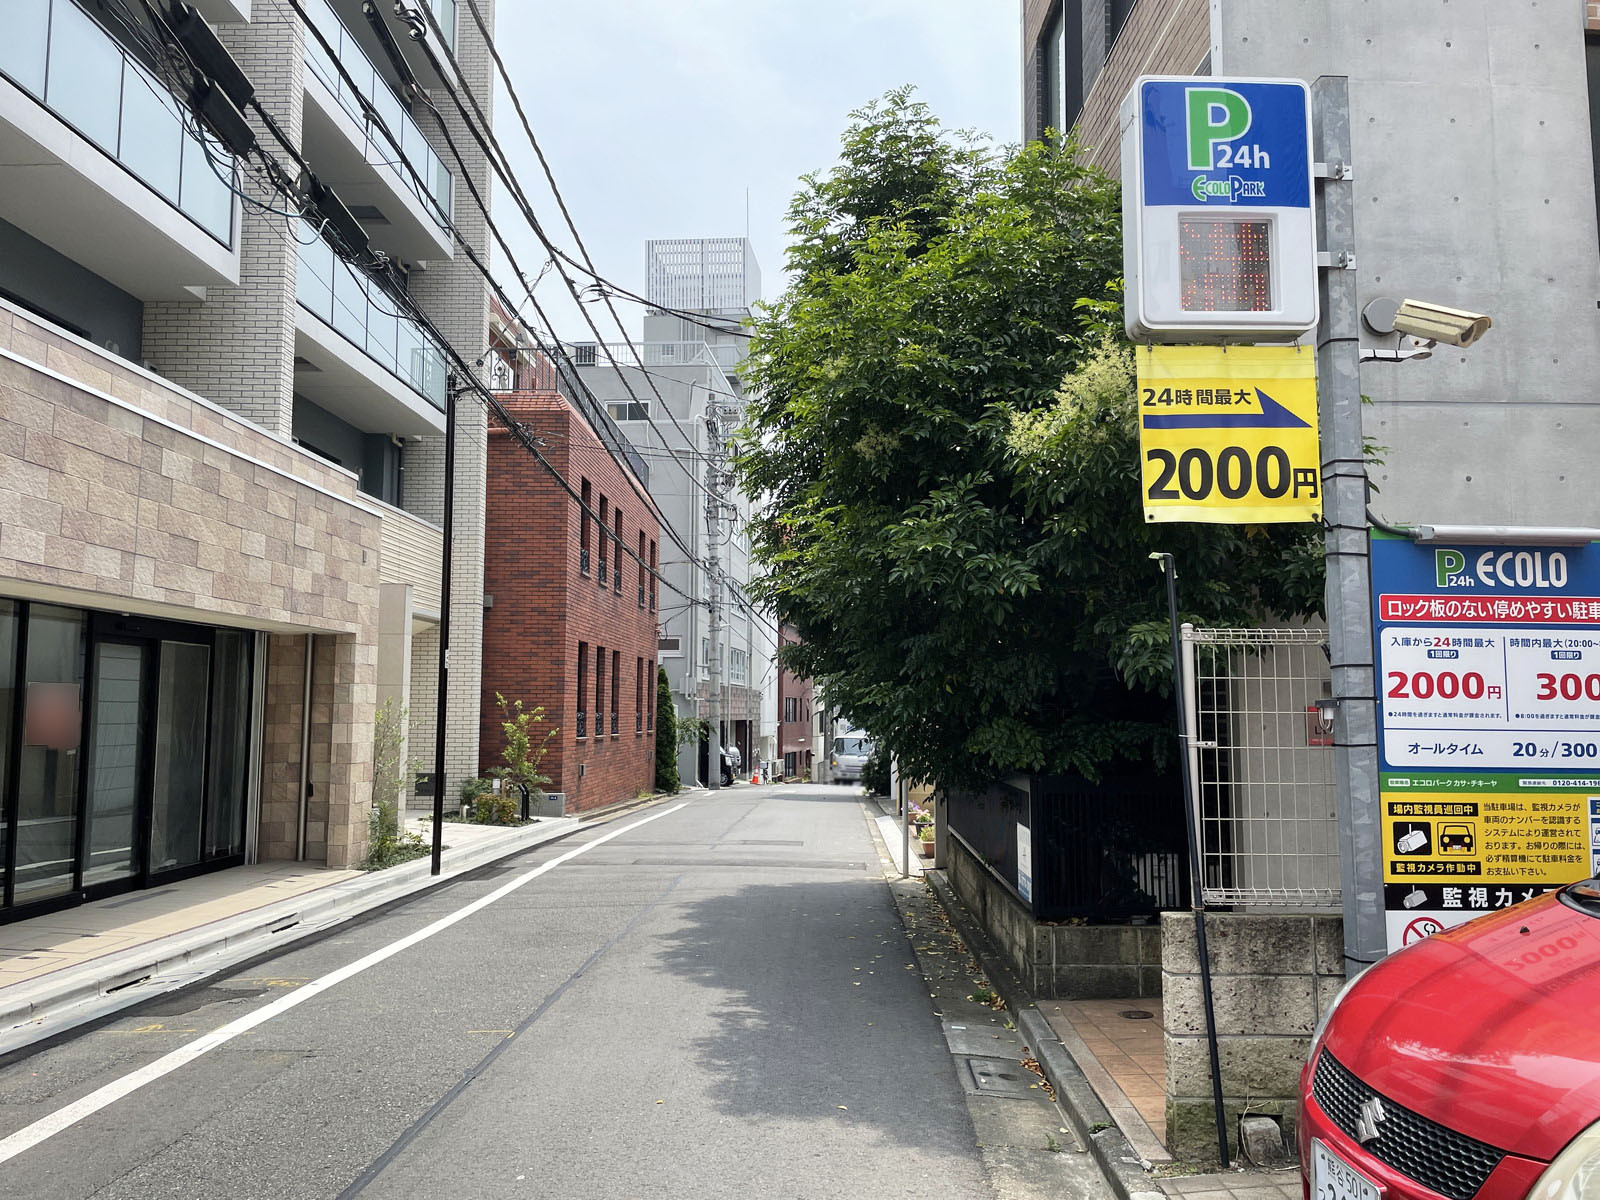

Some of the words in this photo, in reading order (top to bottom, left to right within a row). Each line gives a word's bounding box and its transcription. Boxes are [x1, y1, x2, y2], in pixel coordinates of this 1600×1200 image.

[1185, 87, 1253, 171] P
[1216, 144, 1271, 169] 24h
[1142, 388, 1253, 408] 24時間最大
[1147, 446, 1319, 501] 2000円
[1435, 549, 1466, 588] P
[1476, 551, 1568, 588] ECOLO
[1449, 575, 1475, 588] 24h
[1387, 599, 1600, 620] ロック板のない停めやすい駐車
[1390, 636, 1496, 649] 入庫から24時間最大
[1509, 638, 1600, 650] 時間内最大(20:00~
[1430, 650, 1457, 658] 1回限り
[1553, 651, 1580, 660] 1回限り
[1387, 671, 1502, 700] 2000円
[1407, 742, 1484, 756] オールタイム
[1393, 804, 1474, 815] 場内監視員巡回中
[1483, 803, 1581, 813] 当駐車場は、監視カメラが
[1483, 816, 1581, 825] 車両のナンバーを認識する
[1484, 828, 1582, 838] システムにより運営されて
[1485, 854, 1583, 864] 必ず精算機にて駐車料金を
[1395, 863, 1477, 874] 監視カメラ作動中
[1486, 867, 1549, 877] お支払い下さい。
[1442, 887, 1554, 908] 監視カメ
